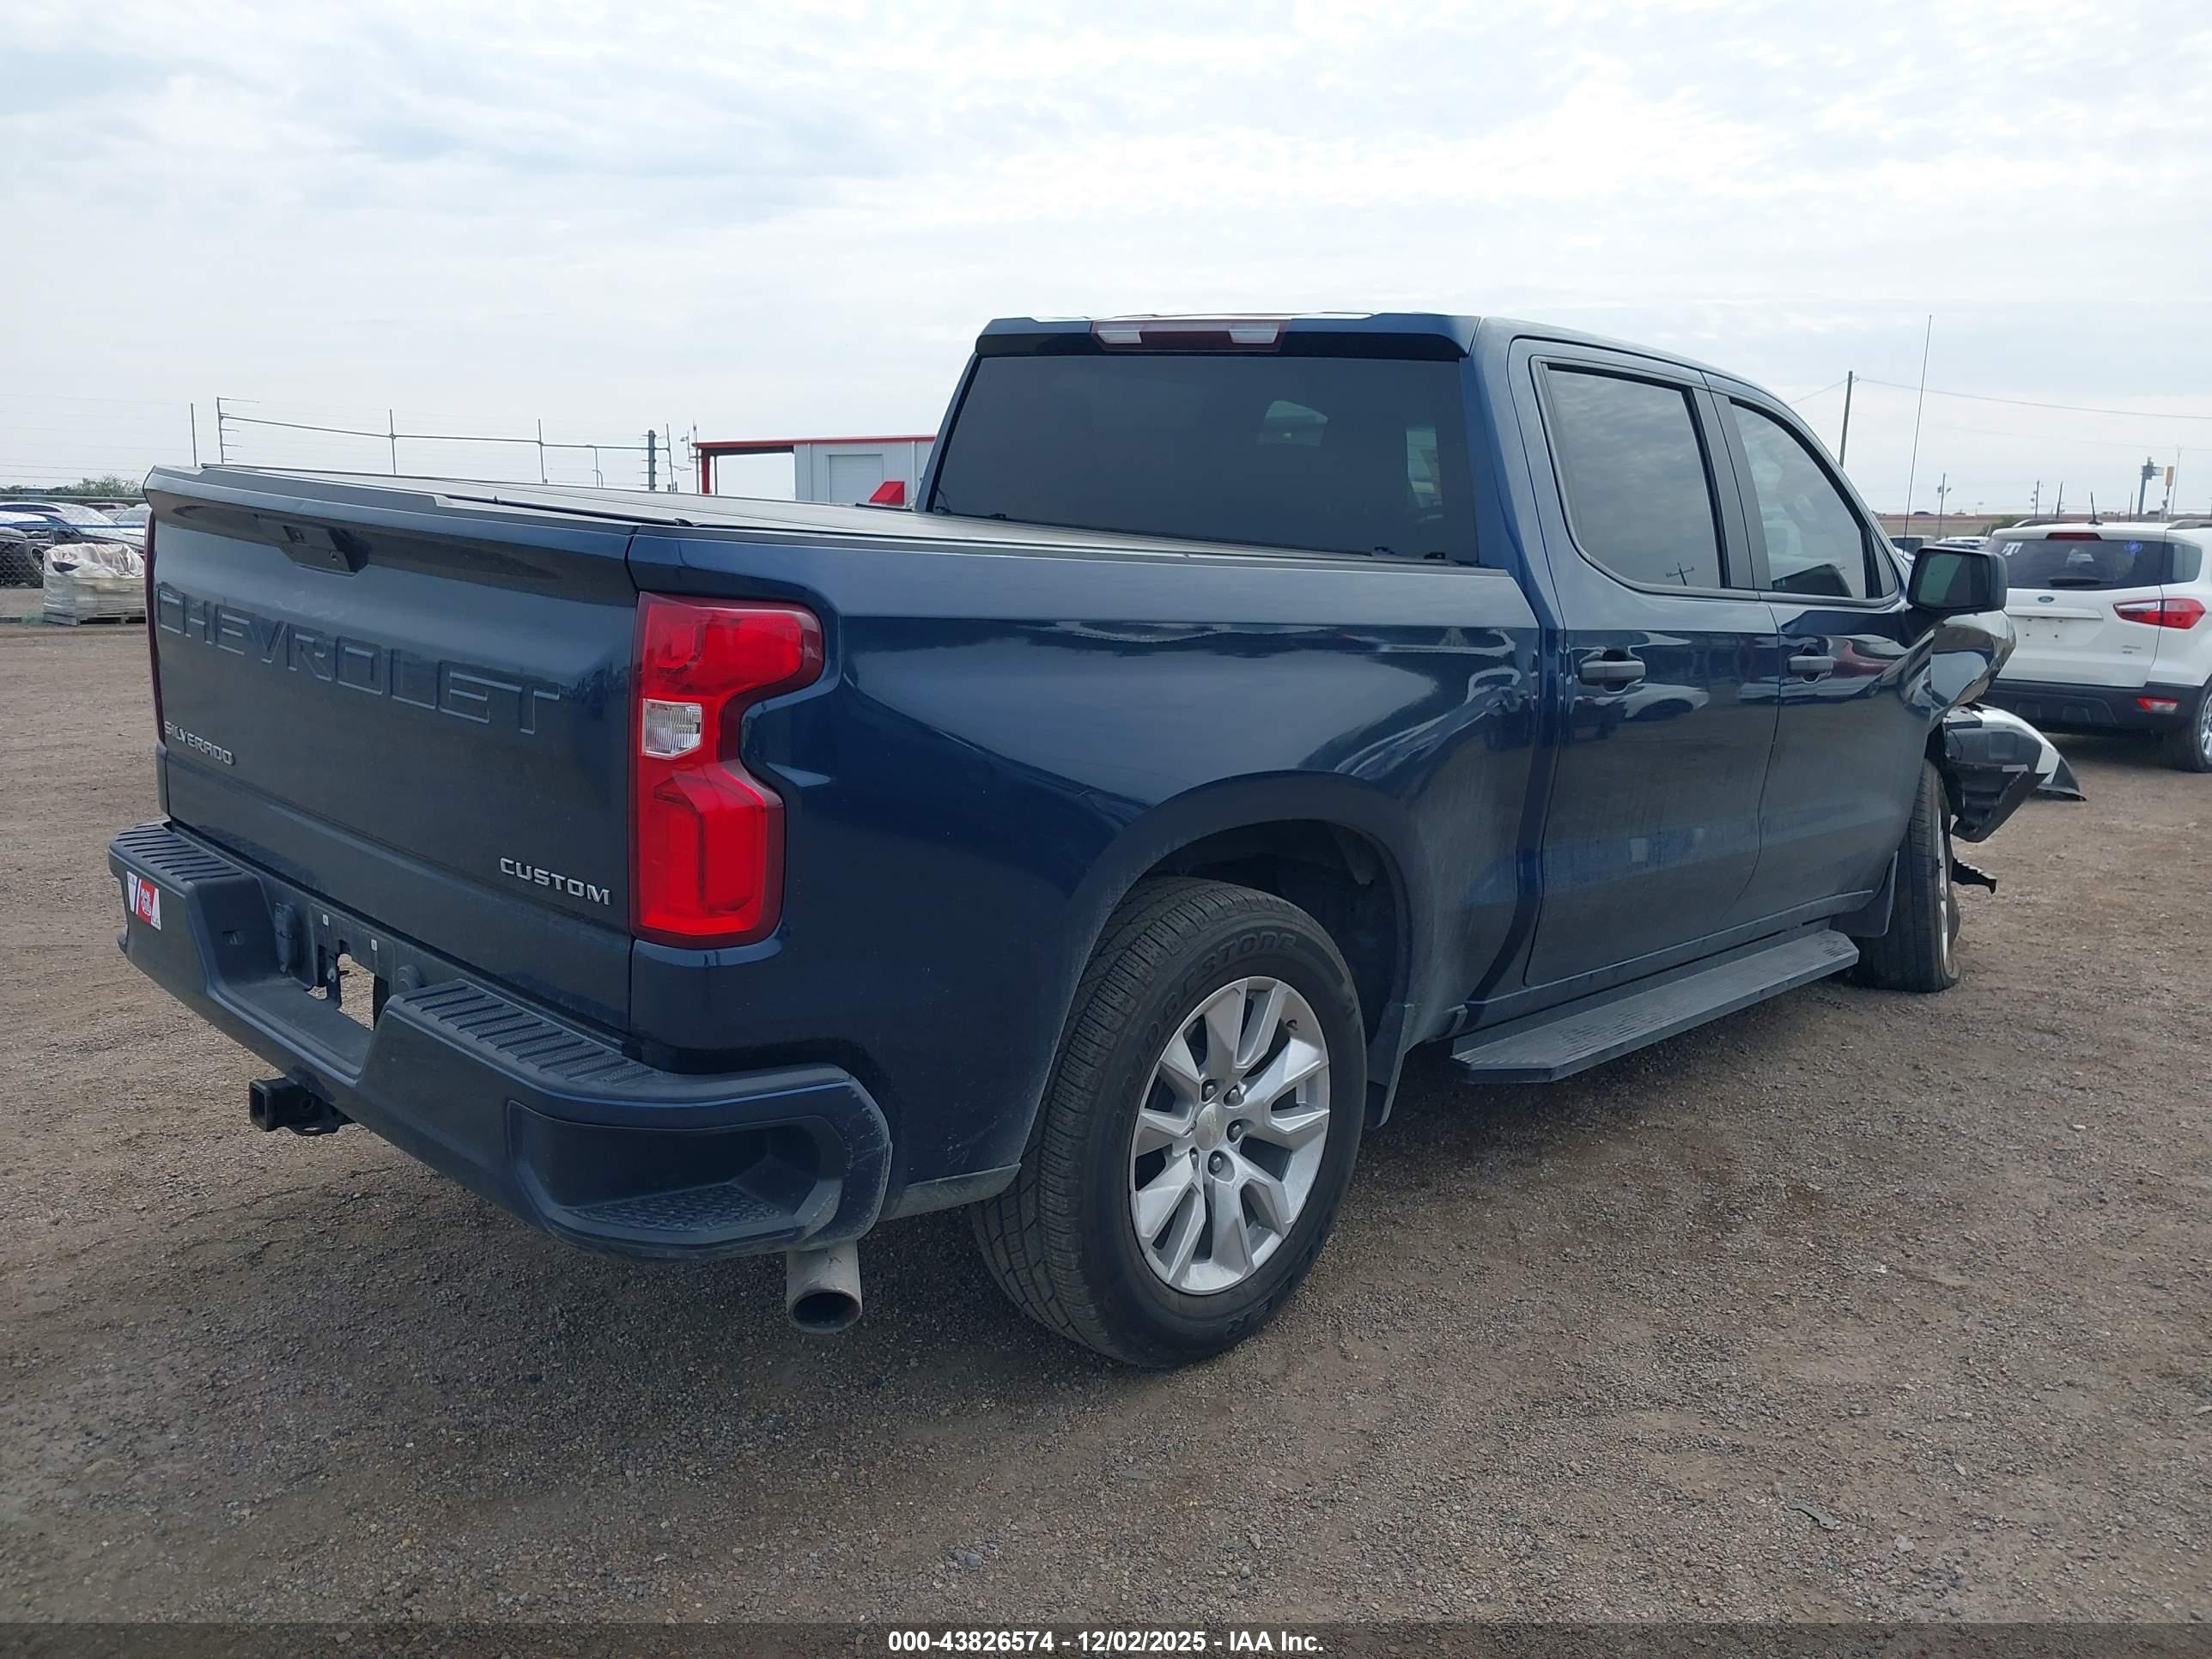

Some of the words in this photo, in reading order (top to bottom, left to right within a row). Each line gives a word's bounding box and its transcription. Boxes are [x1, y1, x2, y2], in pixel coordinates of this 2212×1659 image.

[157, 586, 560, 735] CHEVROLET
[164, 720, 234, 766] SILVERADO
[500, 857, 611, 906] CUSTOM
